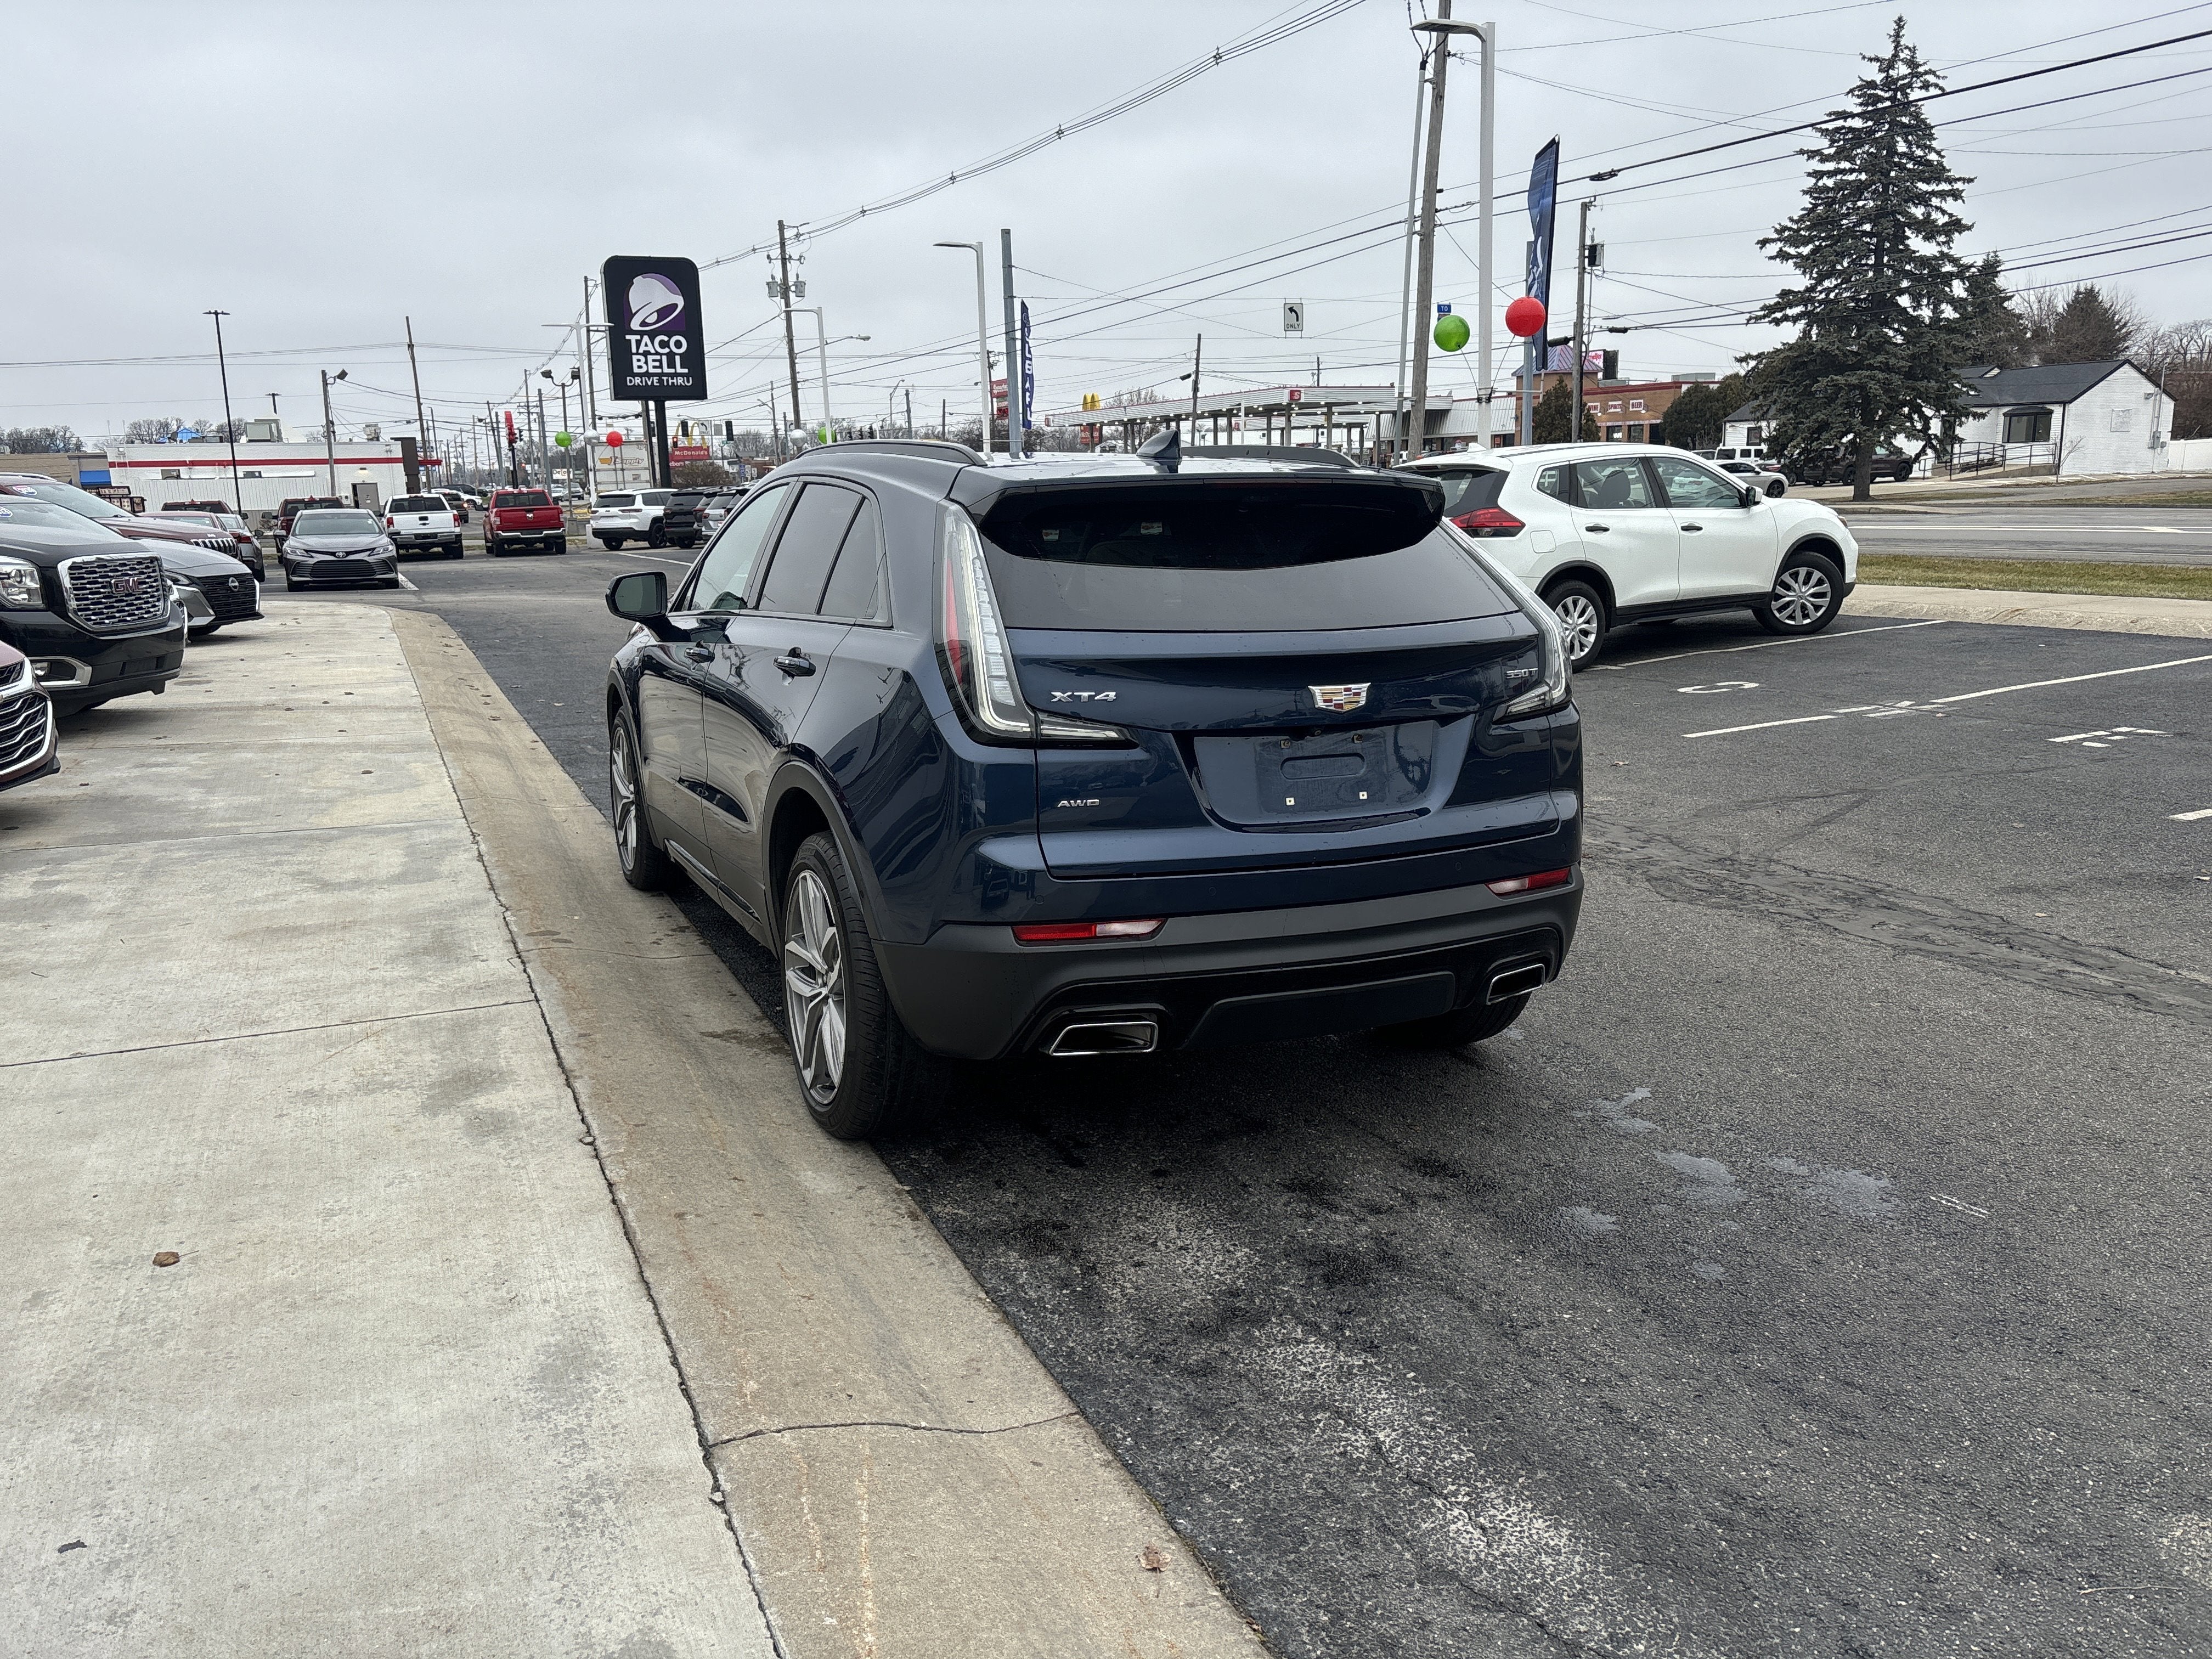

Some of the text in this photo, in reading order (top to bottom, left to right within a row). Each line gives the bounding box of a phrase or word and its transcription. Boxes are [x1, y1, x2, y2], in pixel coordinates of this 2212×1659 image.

[625, 335, 687, 354] TACO
[632, 355, 689, 374] BELL
[627, 376, 692, 386] DRIVE THRU
[1631, 401, 1643, 409] BEER
[112, 577, 144, 594] GMC
[1506, 668, 1538, 679] 350T
[1050, 692, 1117, 702] XT4
[1057, 799, 1099, 808] AWD
